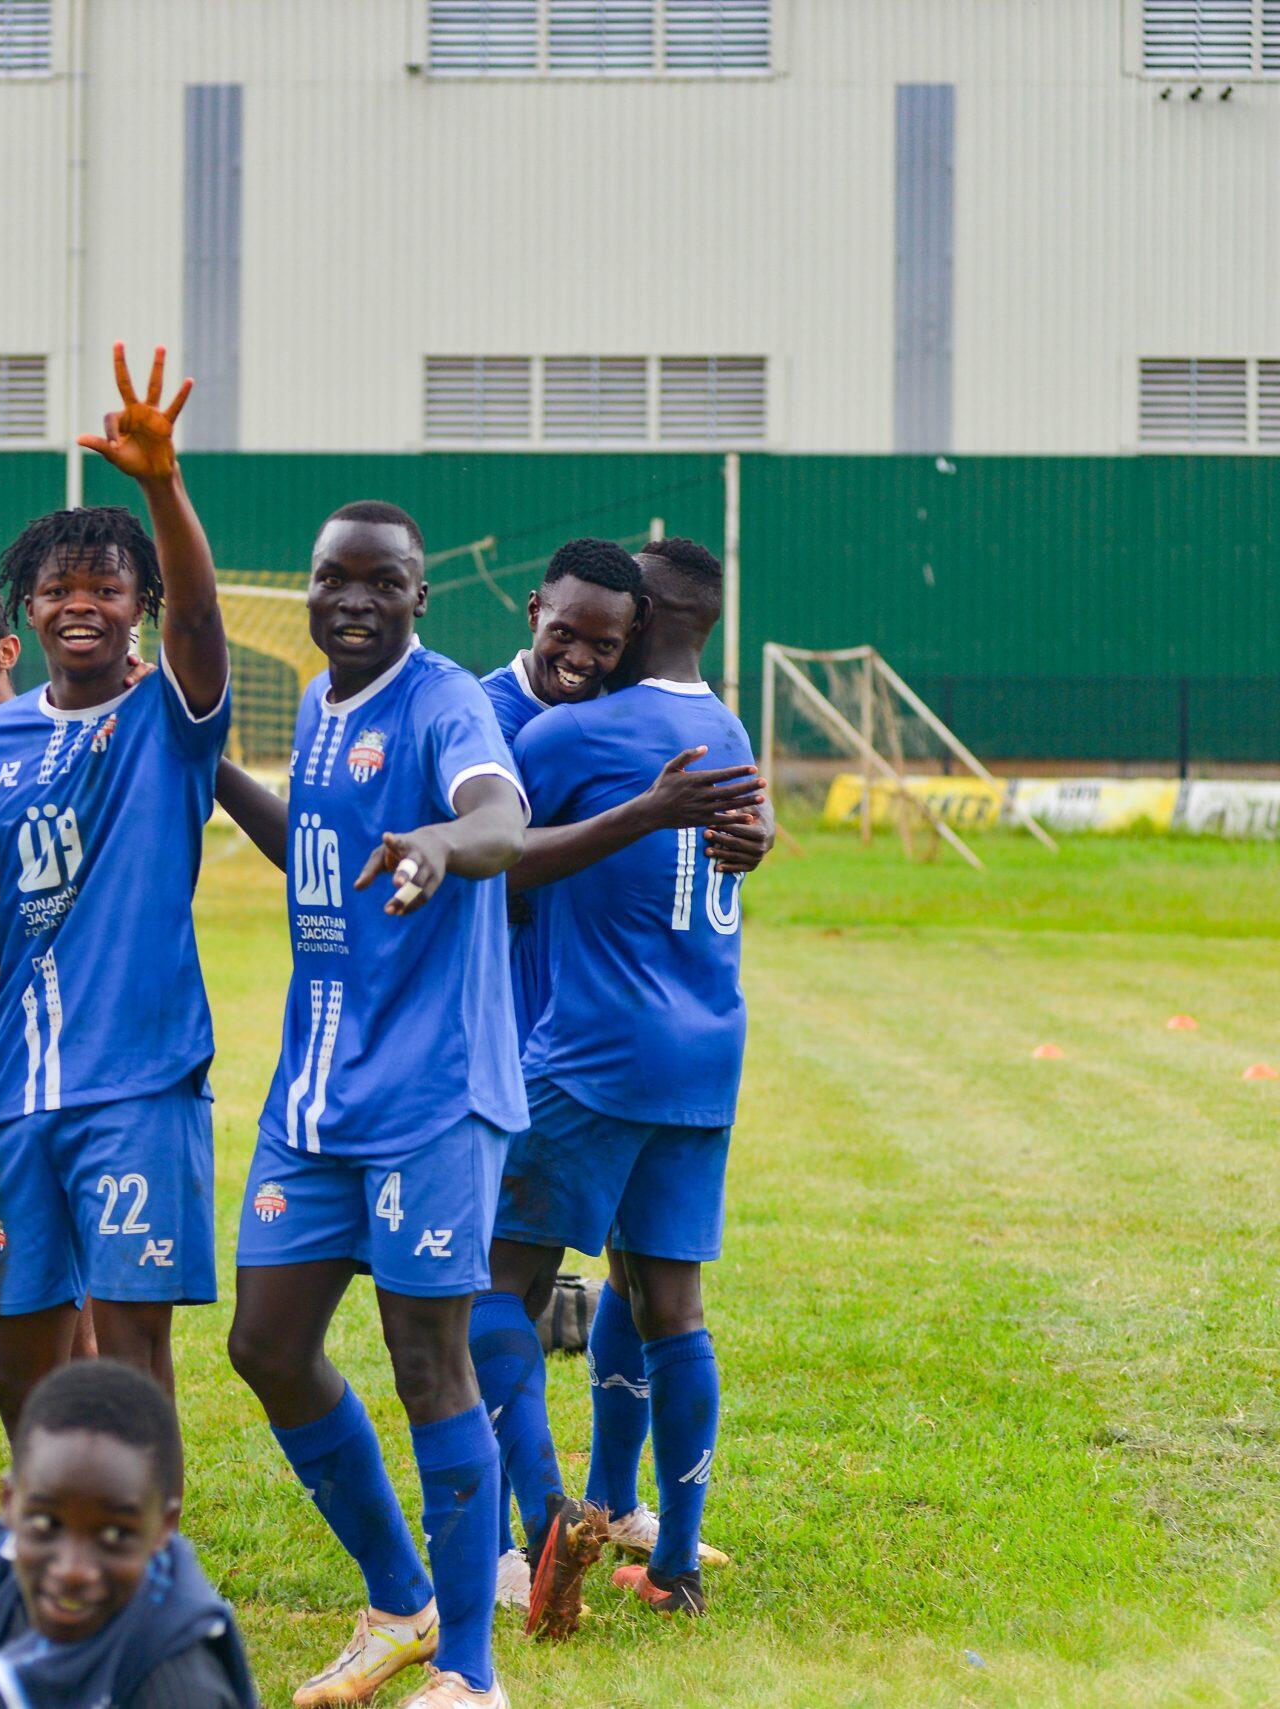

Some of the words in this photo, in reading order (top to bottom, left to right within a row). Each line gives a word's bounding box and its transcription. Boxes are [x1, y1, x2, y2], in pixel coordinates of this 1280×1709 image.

[19, 885, 78, 915] JONATAN
[96, 1173, 150, 1235] 22
[376, 1171, 404, 1232] 4
[138, 1239, 174, 1267] AZ
[414, 1229, 453, 1257] AZ
